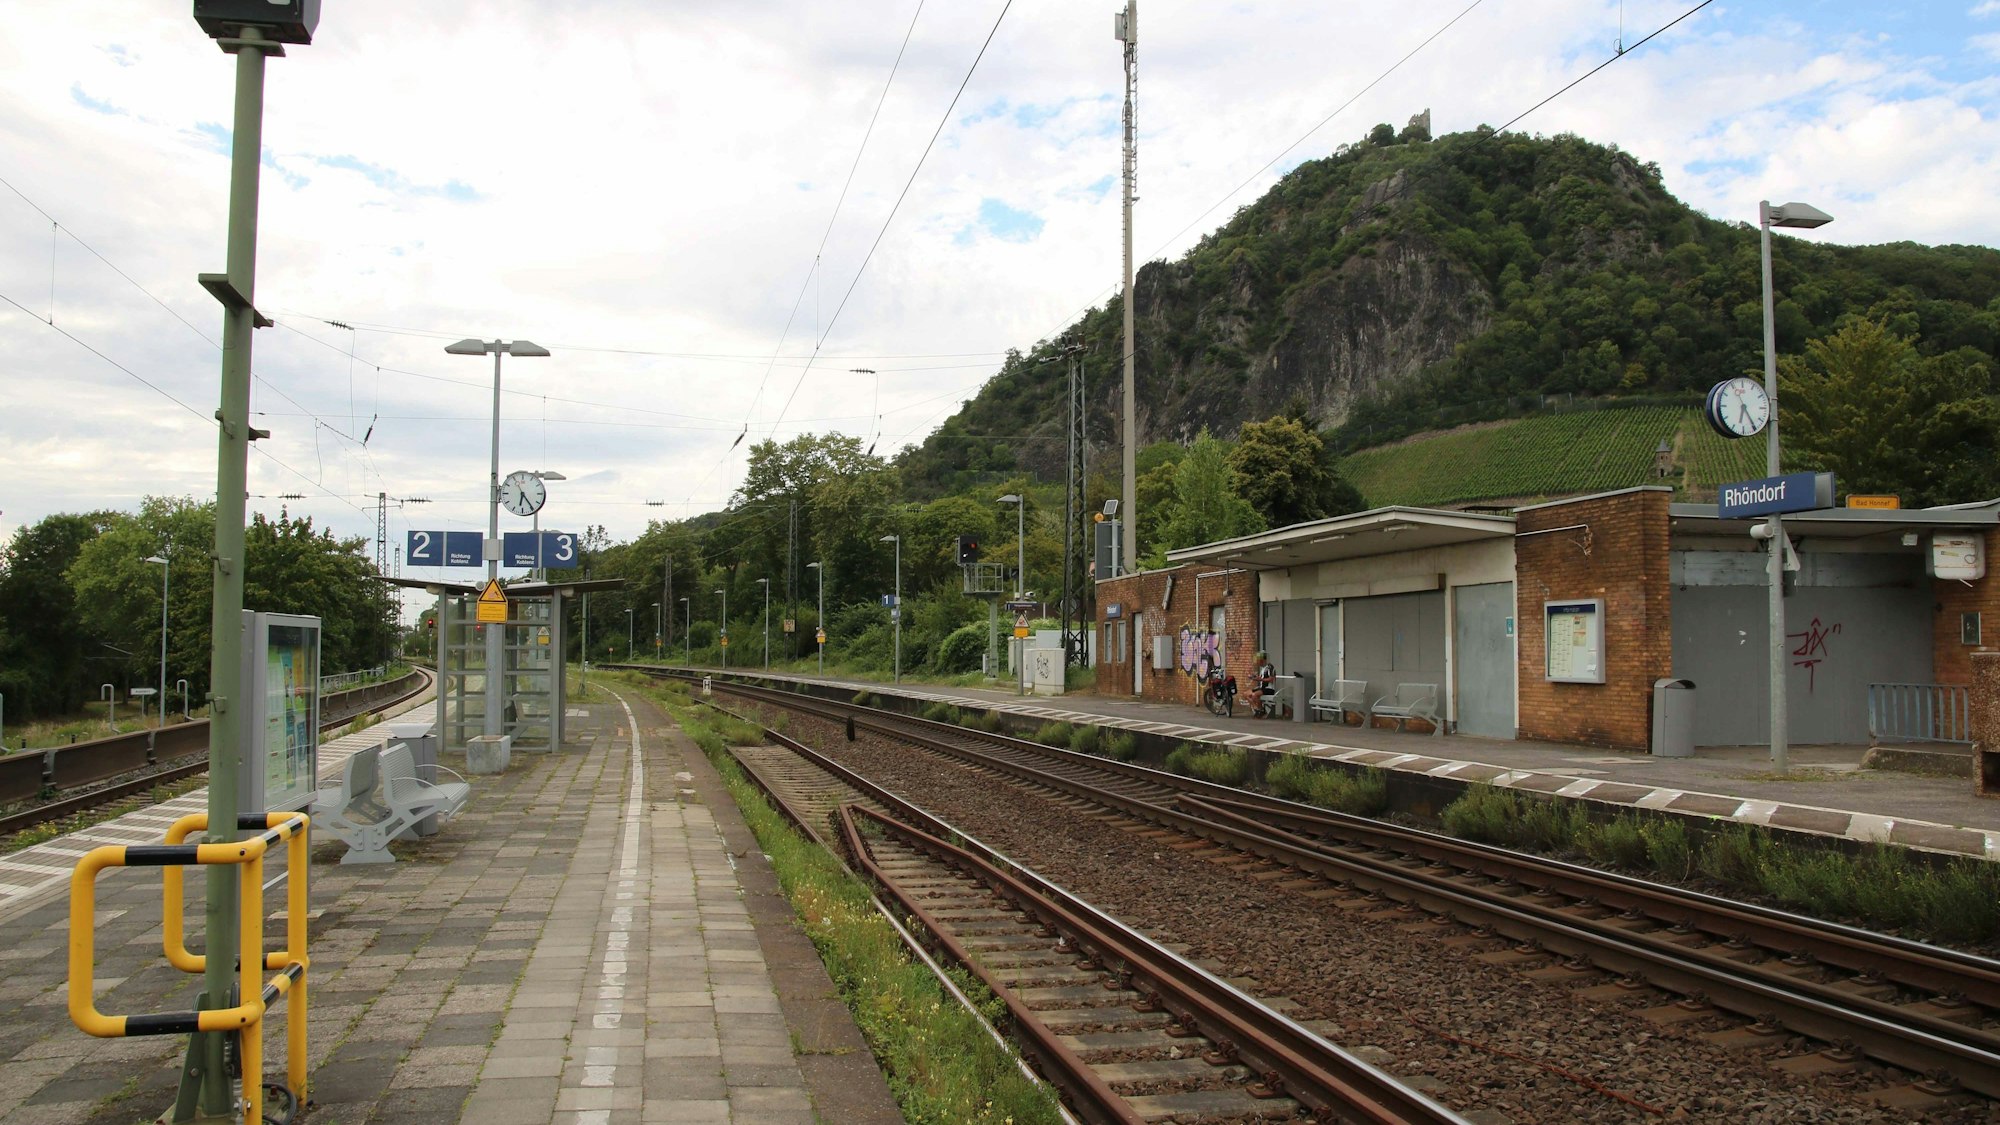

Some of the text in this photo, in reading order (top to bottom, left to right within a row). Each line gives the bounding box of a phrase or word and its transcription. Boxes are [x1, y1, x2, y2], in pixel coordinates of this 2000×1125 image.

[1725, 481, 1786, 507] Rhöndorf
[412, 532, 430, 558] 2
[556, 534, 573, 561] 3
[884, 594, 889, 604] 1
[704, 680, 710, 690] H
